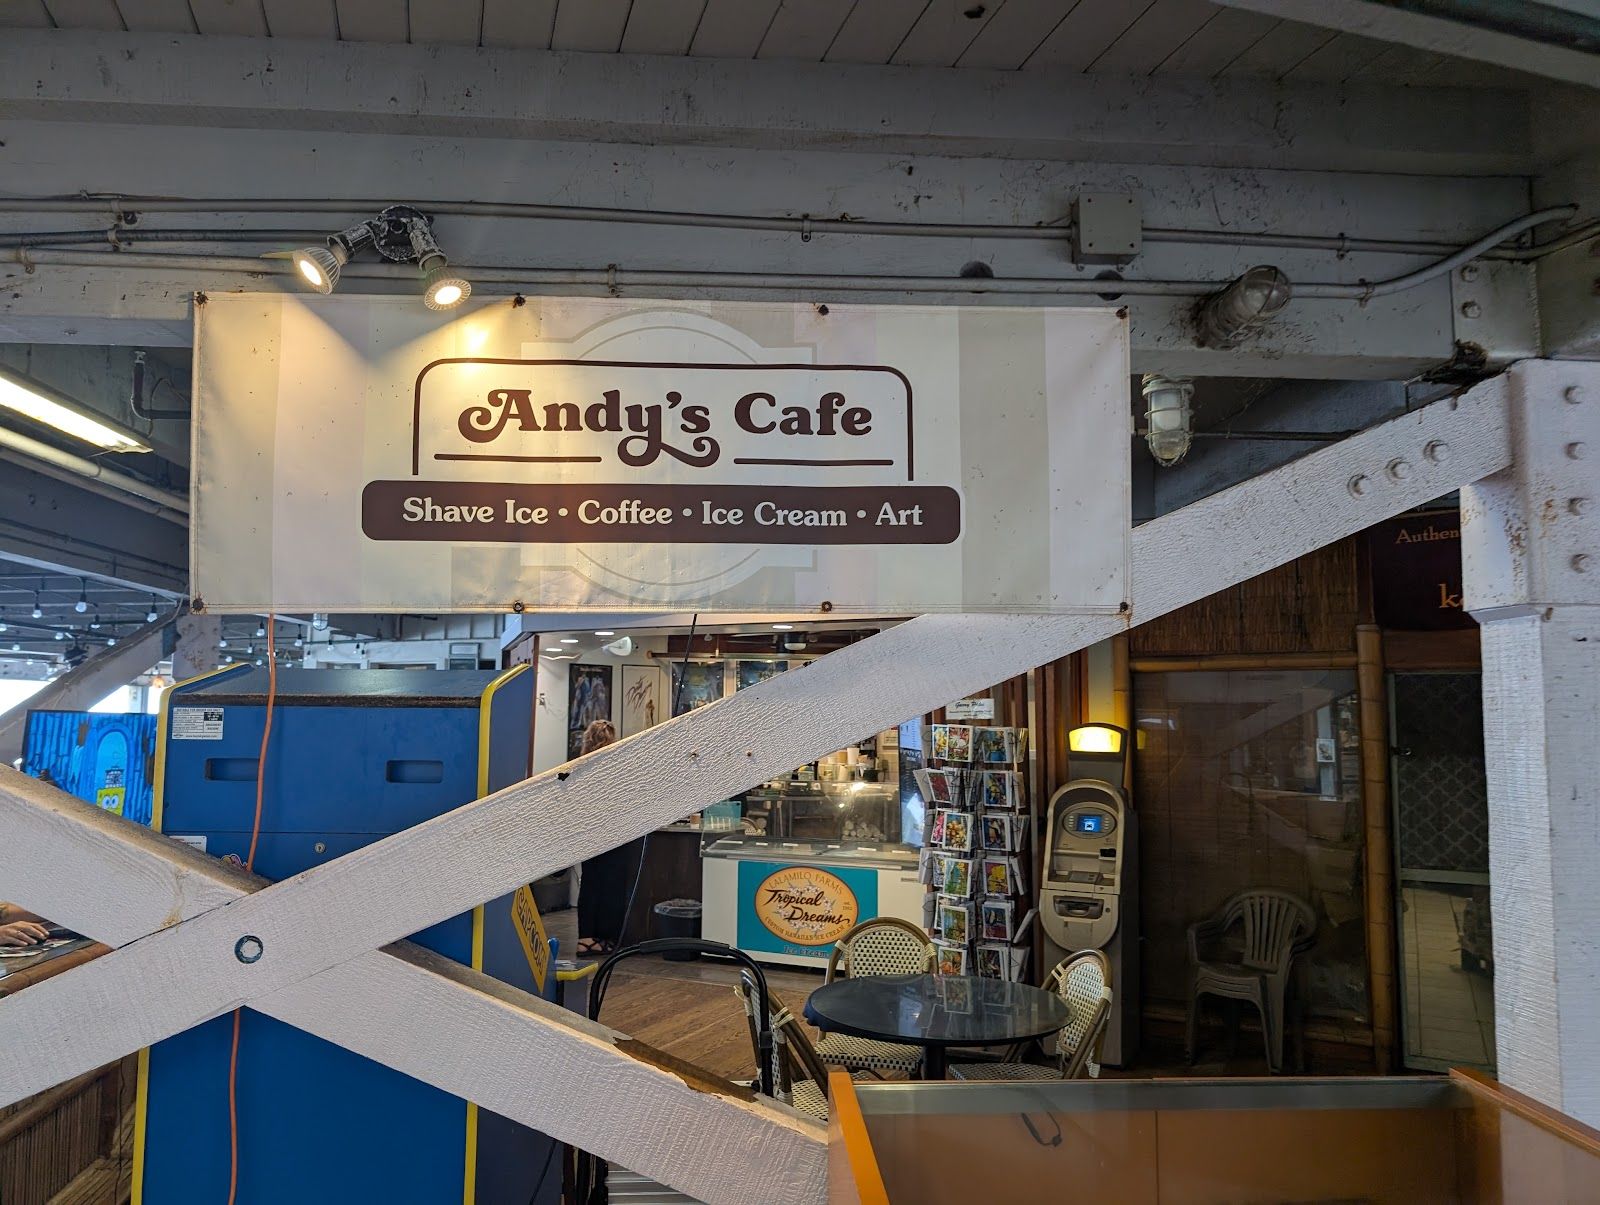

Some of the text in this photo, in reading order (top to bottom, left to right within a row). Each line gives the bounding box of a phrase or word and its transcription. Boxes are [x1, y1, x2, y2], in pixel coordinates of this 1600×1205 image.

[458, 389, 872, 467] Andy's Cafe
[402, 496, 923, 529] Shave Ice Coffee Ice Cream Art
[1395, 526, 1461, 544] Authen
[768, 871, 844, 895] LALAMILO FARMS
[763, 888, 825, 909] Tropical
[783, 905, 851, 925] Dreams
[516, 886, 546, 976] CAPCOM
